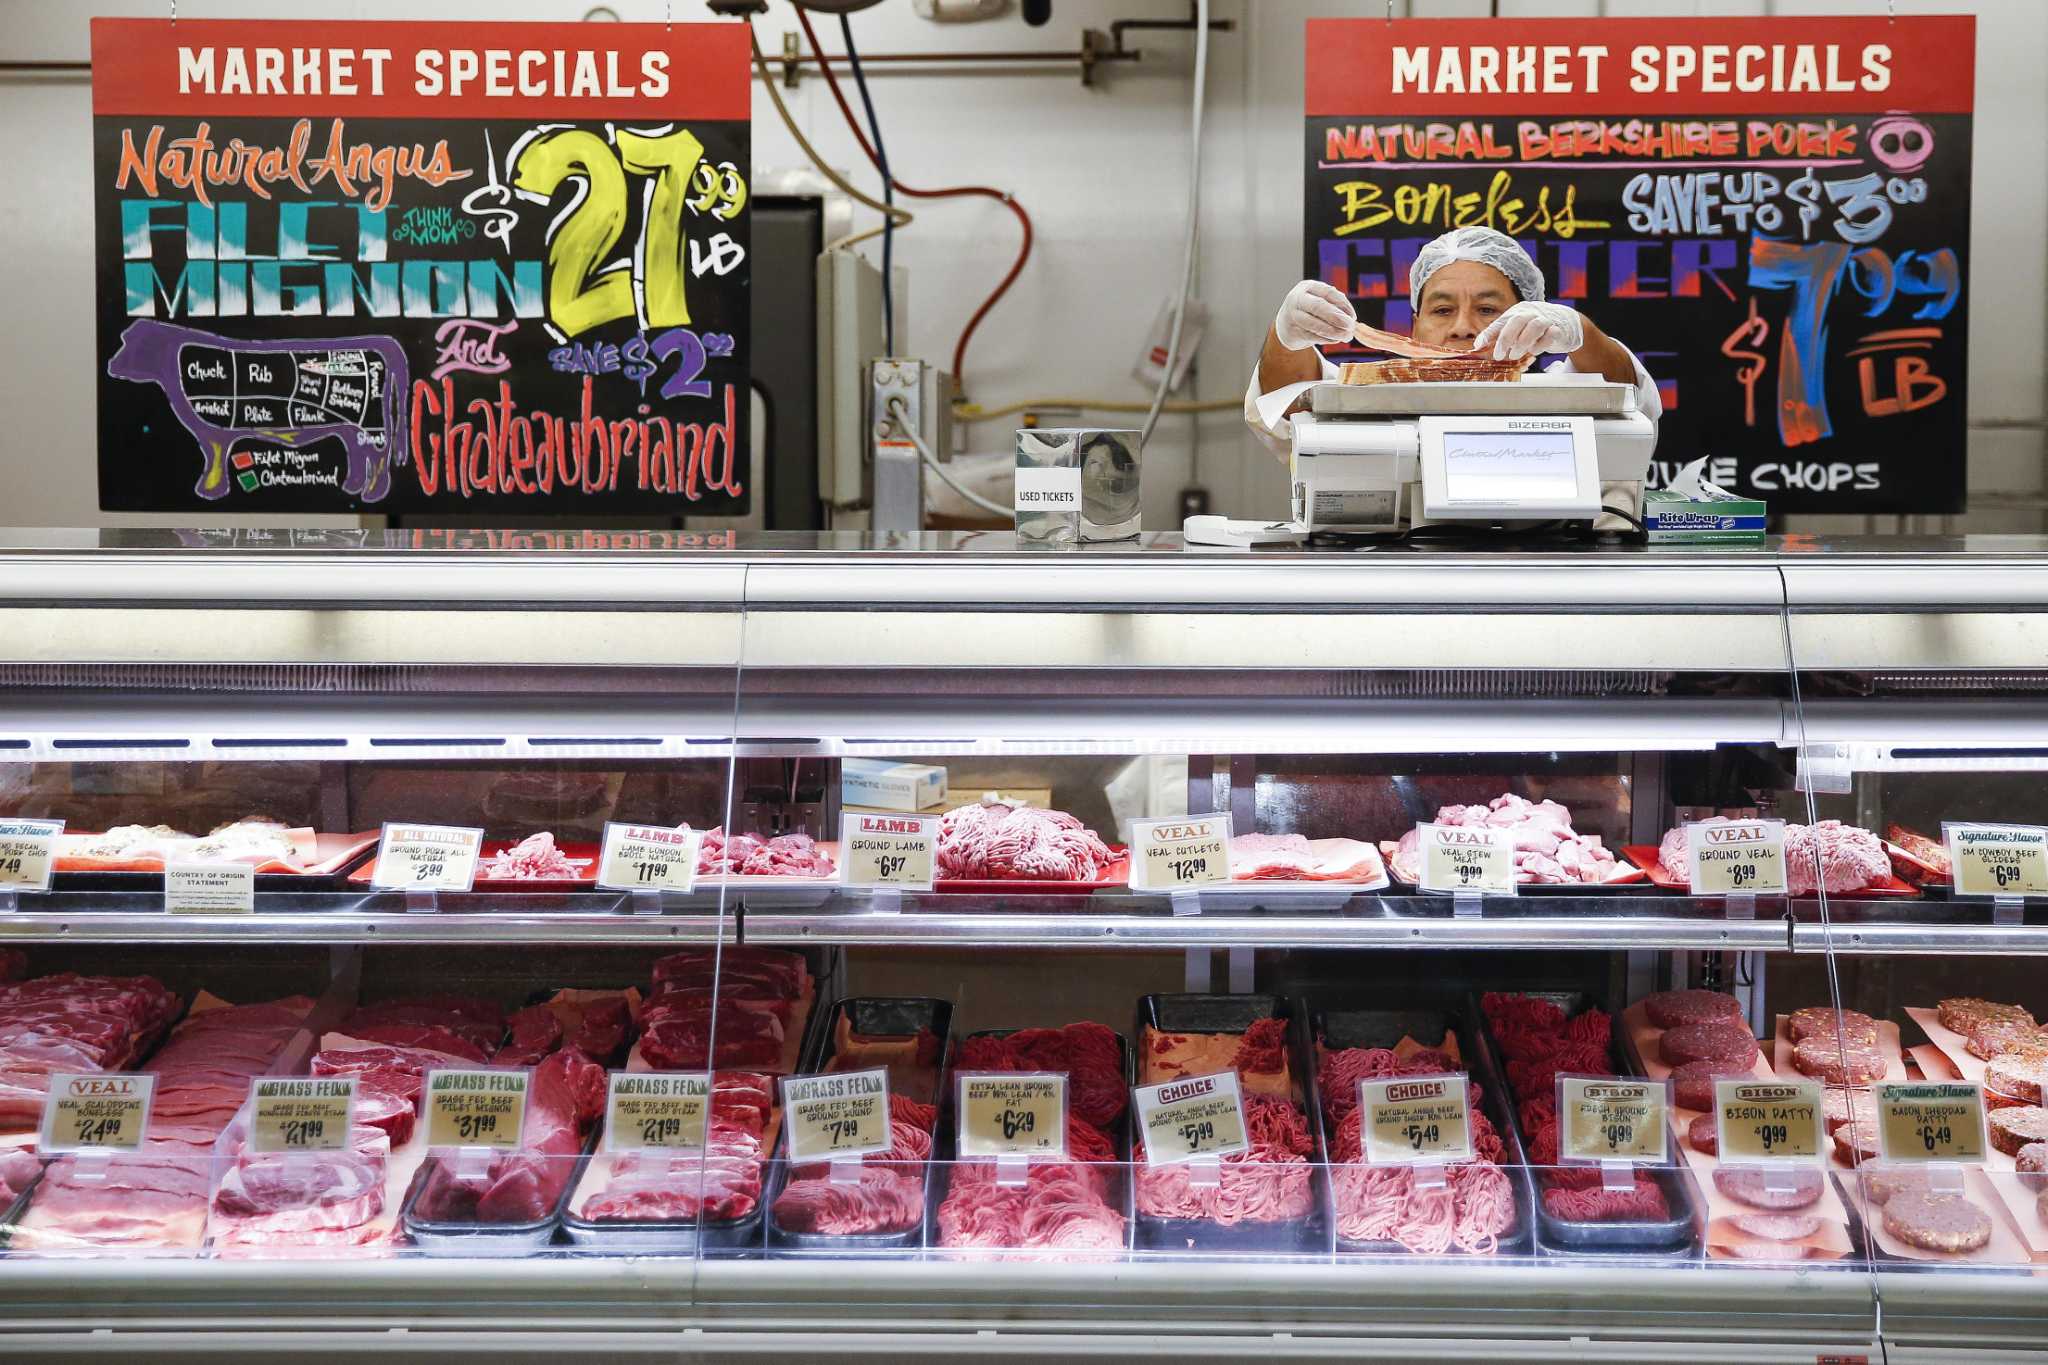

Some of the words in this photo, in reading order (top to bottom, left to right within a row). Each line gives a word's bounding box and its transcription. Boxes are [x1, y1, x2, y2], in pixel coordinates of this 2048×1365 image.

[178, 47, 392, 96] MARKET
[414, 49, 671, 97] SPECIALS
[1391, 46, 1608, 93] MARKET
[1630, 44, 1892, 93] SPECIALS
[1326, 121, 1513, 162] NATURAL
[1517, 119, 1740, 161] BERKSHIRE
[1746, 119, 1859, 158] PORK
[115, 120, 313, 210] Natural
[304, 117, 473, 213] Angus
[1722, 172, 1780, 204] UP
[1621, 172, 1722, 235] SAVE
[402, 206, 453, 229] THINK
[1721, 203, 1783, 232] TO
[120, 199, 400, 262] FILET
[409, 223, 459, 246] MOM
[688, 232, 746, 279] LB
[123, 260, 546, 320] MIGNON
[433, 320, 517, 375] And
[548, 340, 621, 375] SAVE
[187, 361, 227, 379] Chuck
[248, 363, 273, 383] Rib
[1857, 355, 1948, 418] LB
[243, 405, 274, 422] Plate
[294, 406, 326, 422] Flank
[1508, 421, 1572, 429] BIZERBA
[410, 374, 743, 501] Chateaubriand
[253, 451, 280, 465] Filet
[283, 451, 319, 468] Mignon
[260, 466, 339, 488] Chateaubriand
[1750, 460, 1881, 492] CHOPS
[1020, 491, 1041, 502] USED
[1042, 491, 1074, 502] TICKETS
[1658, 512, 1685, 524] Rite
[1685, 512, 1720, 526] Wrap
[863, 818, 921, 833] LAMB
[1156, 824, 1210, 839] VEAL
[1711, 827, 1765, 841] VEAL
[627, 827, 684, 845] LAMB
[1440, 831, 1494, 846] VEAL
[1957, 830, 2008, 844] Signature
[2009, 831, 2043, 843] Flavor
[390, 846, 421, 854] GROUND
[425, 847, 445, 855] PORK
[450, 849, 468, 857] ALL
[621, 844, 646, 853] LAMB
[648, 847, 681, 857] LONDON
[851, 839, 891, 850] GROUND
[895, 841, 926, 852] LAMB
[1146, 847, 1172, 857] VEAL
[1176, 842, 1221, 856] CUTLETS
[1441, 848, 1462, 856] VEAL
[1466, 850, 1491, 859] STEW
[1962, 848, 1975, 856] CM
[1978, 847, 2011, 857] COWBOY
[410, 854, 447, 862] NATURAL
[619, 851, 643, 859] BROIL
[648, 854, 686, 864] NATURAL
[1453, 856, 1478, 865] MEAT
[1700, 849, 1741, 861] GROUND
[1746, 848, 1775, 860] VEAL
[71, 1080, 132, 1094] VEAL
[272, 1081, 313, 1096] GRASS
[316, 1082, 338, 1097] FED
[447, 1074, 487, 1091] GRASS
[489, 1075, 512, 1092] FED
[629, 1079, 669, 1095] GRASS
[672, 1080, 694, 1096] FED
[804, 1079, 844, 1099] GRASS
[848, 1077, 868, 1095] FED
[1160, 1078, 1214, 1101] CHOICE
[1389, 1082, 1443, 1100] CHOICE
[1011, 1090, 1032, 1099] LEAN
[1589, 1087, 1644, 1098] BISON
[1741, 1087, 1796, 1098] BISON
[1883, 1084, 1937, 1102] Signature
[1938, 1084, 1976, 1098] Flavor
[1005, 1099, 1022, 1108] FAT
[1892, 1106, 1921, 1116] BACON
[1726, 1107, 1766, 1120] BISON
[1772, 1107, 1814, 1120] PATTY
